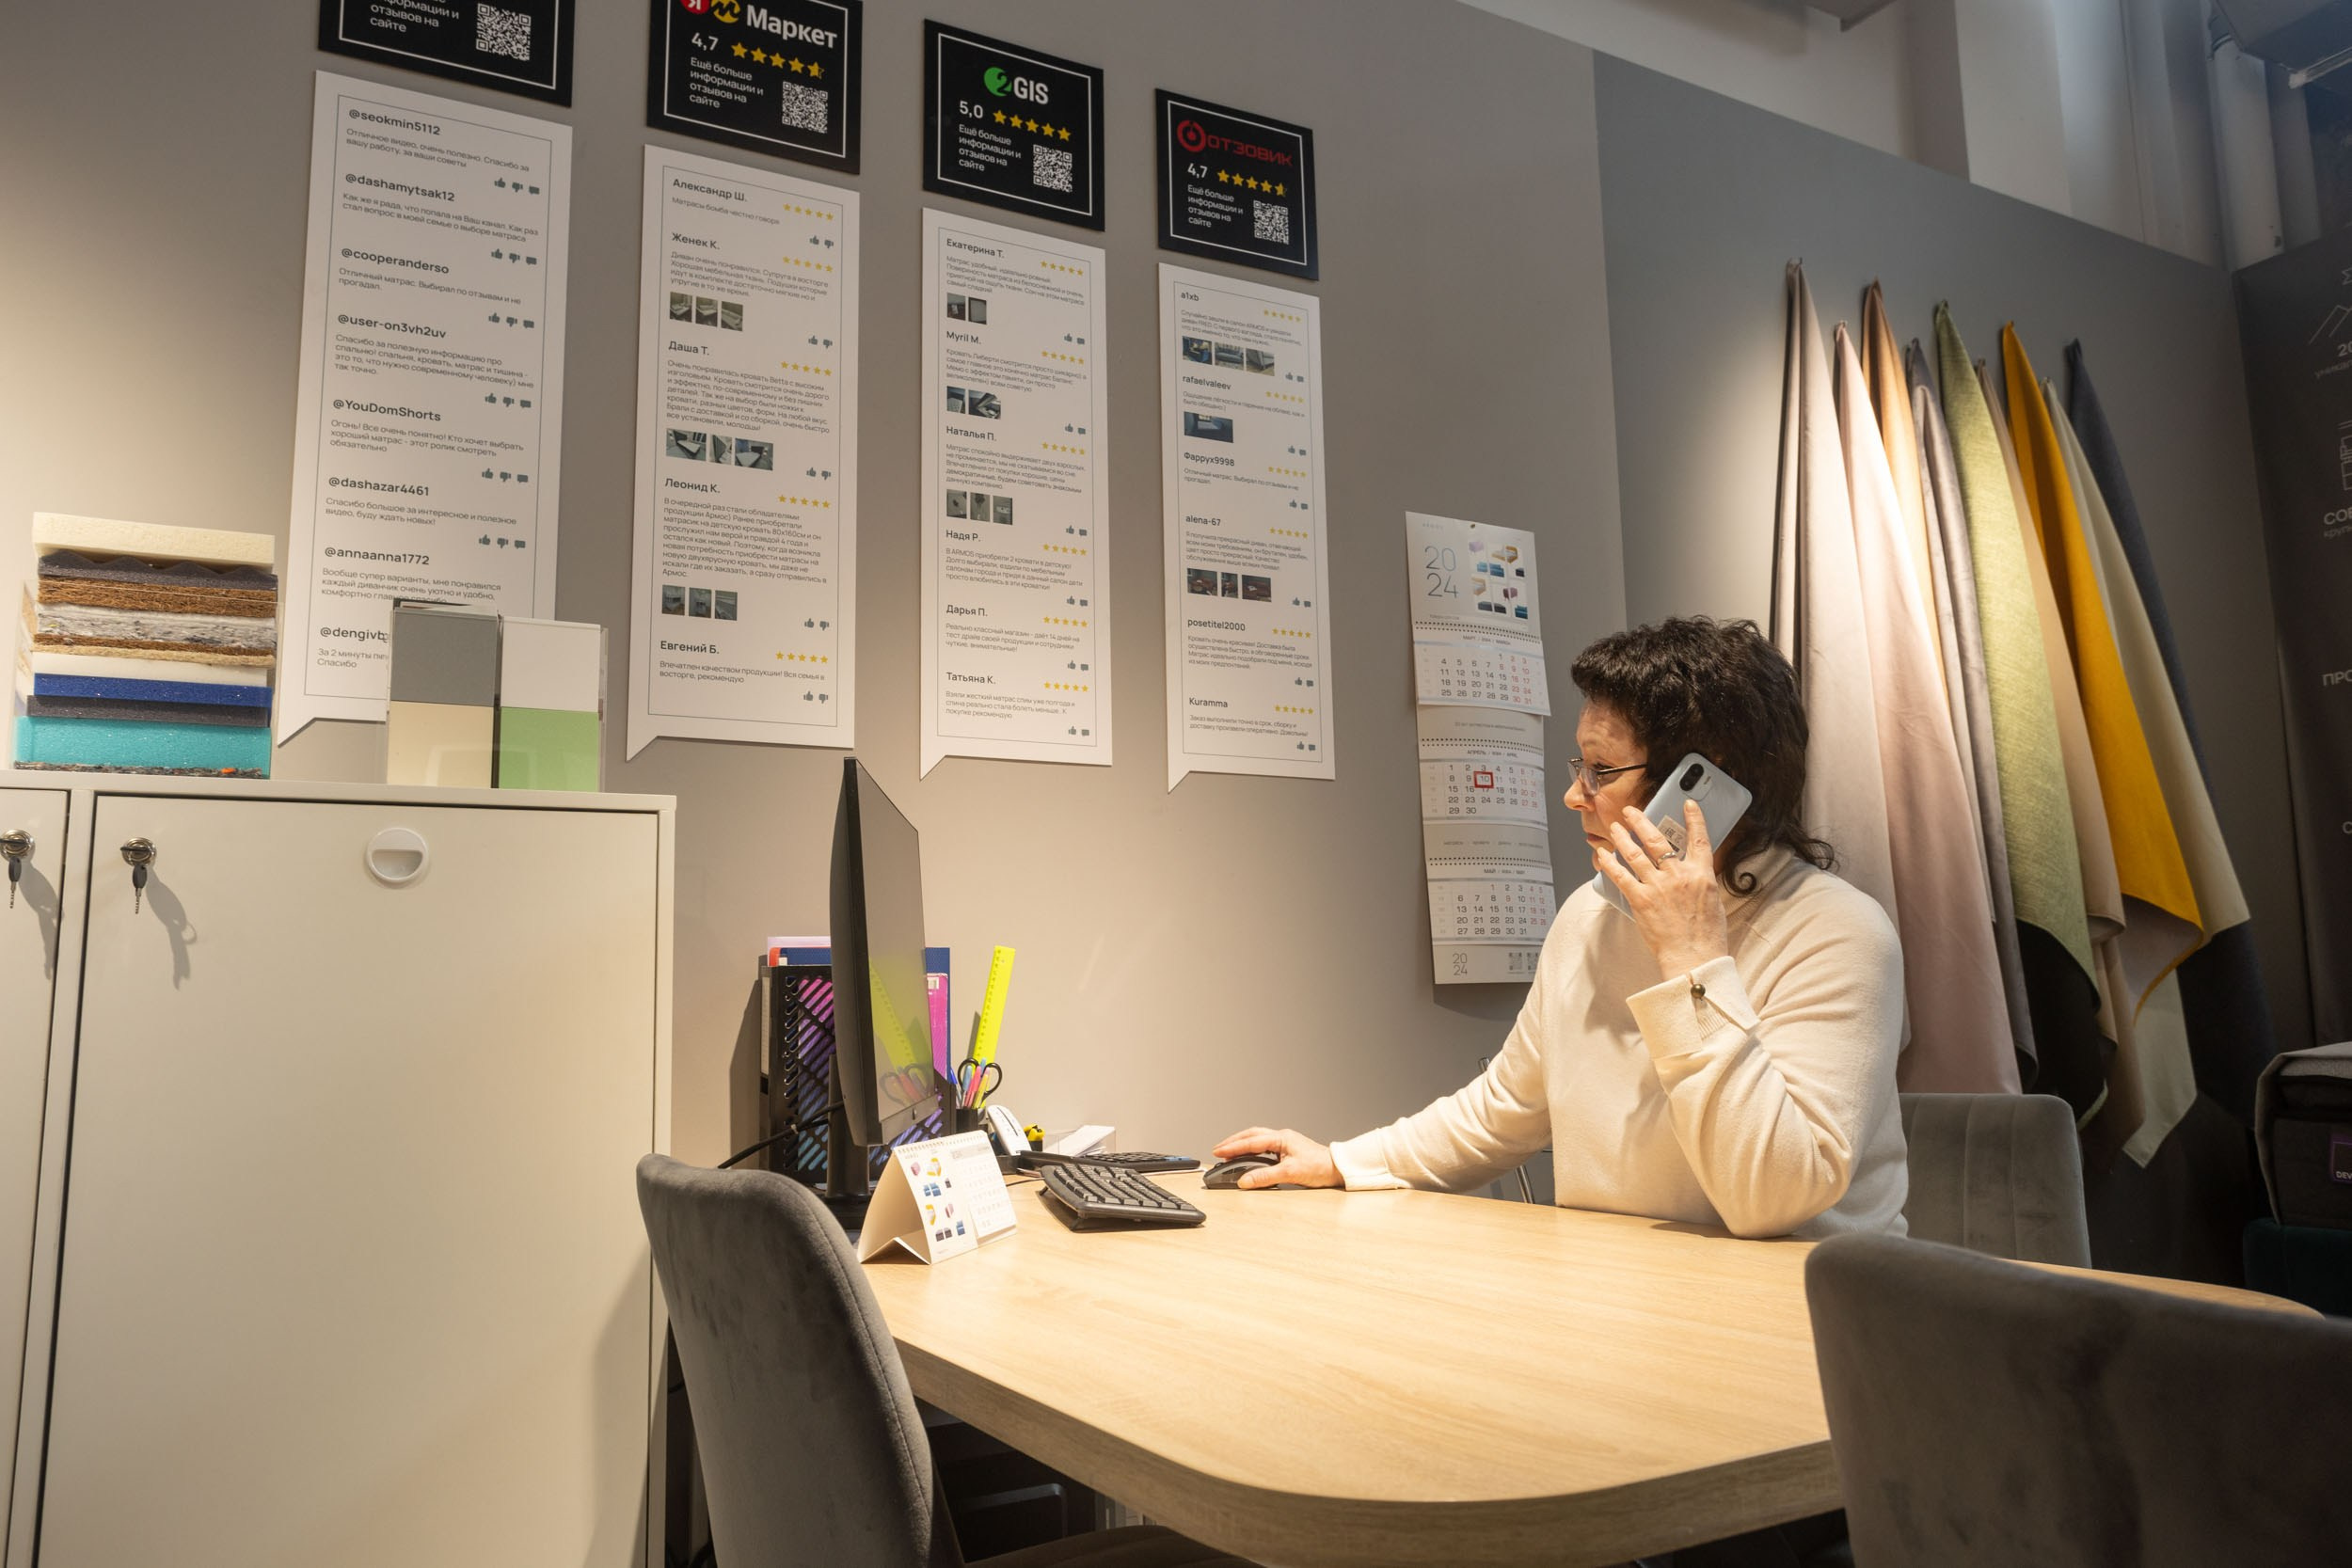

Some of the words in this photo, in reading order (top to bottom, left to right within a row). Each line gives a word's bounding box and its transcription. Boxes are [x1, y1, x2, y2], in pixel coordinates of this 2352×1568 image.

[370, 4, 422, 23] отзывов
[423, 17, 439, 27] на
[370, 17, 406, 32] сайте
[746, 4, 837, 48] Маркет
[691, 32, 718, 50] 4,7
[690, 56, 712, 70] Ещё
[712, 63, 752, 81] больше
[690, 70, 755, 93] информации
[994, 70, 1049, 104] 2GIS
[689, 94, 720, 108] сайте
[690, 82, 732, 99] отзывов
[734, 93, 747, 103] на
[959, 100, 983, 119] 5,0
[348, 108, 440, 135] @seokmin5112
[959, 123, 977, 135] Ещё
[977, 129, 1011, 145] больше
[959, 136, 1013, 156] информации
[958, 147, 995, 163] отзывов
[995, 157, 1007, 166] на
[958, 158, 984, 171] сайте
[1187, 163, 1207, 178] 4,7
[345, 173, 454, 201] @dashamytsak12
[673, 178, 732, 199] Александр
[734, 191, 748, 202] Ш.
[1187, 183, 1203, 195] Ещё
[1204, 188, 1234, 202] больше
[1187, 196, 1237, 213] информации
[1187, 206, 1220, 219] отзывов
[1187, 216, 1211, 228] сайте
[672, 232, 707, 247] Женек
[709, 240, 720, 249] К.
[946, 237, 994, 256] Екатерина
[995, 248, 1004, 258] Т.
[341, 247, 449, 274] @cooperanderso
[338, 314, 446, 338] @user-on3vh2uv
[946, 330, 968, 341] Myril
[970, 334, 982, 344] M.
[667, 340, 698, 353] Даша
[700, 345, 709, 355] Т.
[1182, 375, 1231, 389] rafaelvaleev
[332, 399, 440, 421] @YouDomShorts
[946, 425, 985, 439] Наталья
[987, 432, 996, 440] П.
[1184, 451, 1234, 467] Фаррух9998
[328, 477, 428, 496] @dashazar4461
[664, 477, 707, 493] Леонид
[709, 483, 720, 493] К.
[326, 497, 365, 508] Спасибо
[366, 501, 405, 513] большое
[417, 508, 469, 519] интересное
[476, 515, 516, 525] полезное
[1185, 515, 1220, 526] alena-67
[946, 529, 970, 541] Надя
[972, 532, 980, 541] Р.
[325, 546, 429, 564] @annaanna1772
[1424, 546, 1456, 572] 20
[322, 567, 358, 578] Вообще
[358, 572, 386, 581] супер
[451, 580, 501, 591] понравился
[1426, 572, 1459, 598] 24
[946, 604, 976, 616] Дарья
[977, 607, 987, 616] П.
[1187, 619, 1245, 631] posetitel2000
[660, 640, 707, 653] Евгений
[708, 644, 719, 654] Б.
[946, 672, 985, 683] Татьяна
[986, 675, 995, 684] К.
[1188, 697, 1228, 707] Kuramma
[1452, 953, 1468, 964] 20
[1454, 964, 1469, 976] 24
